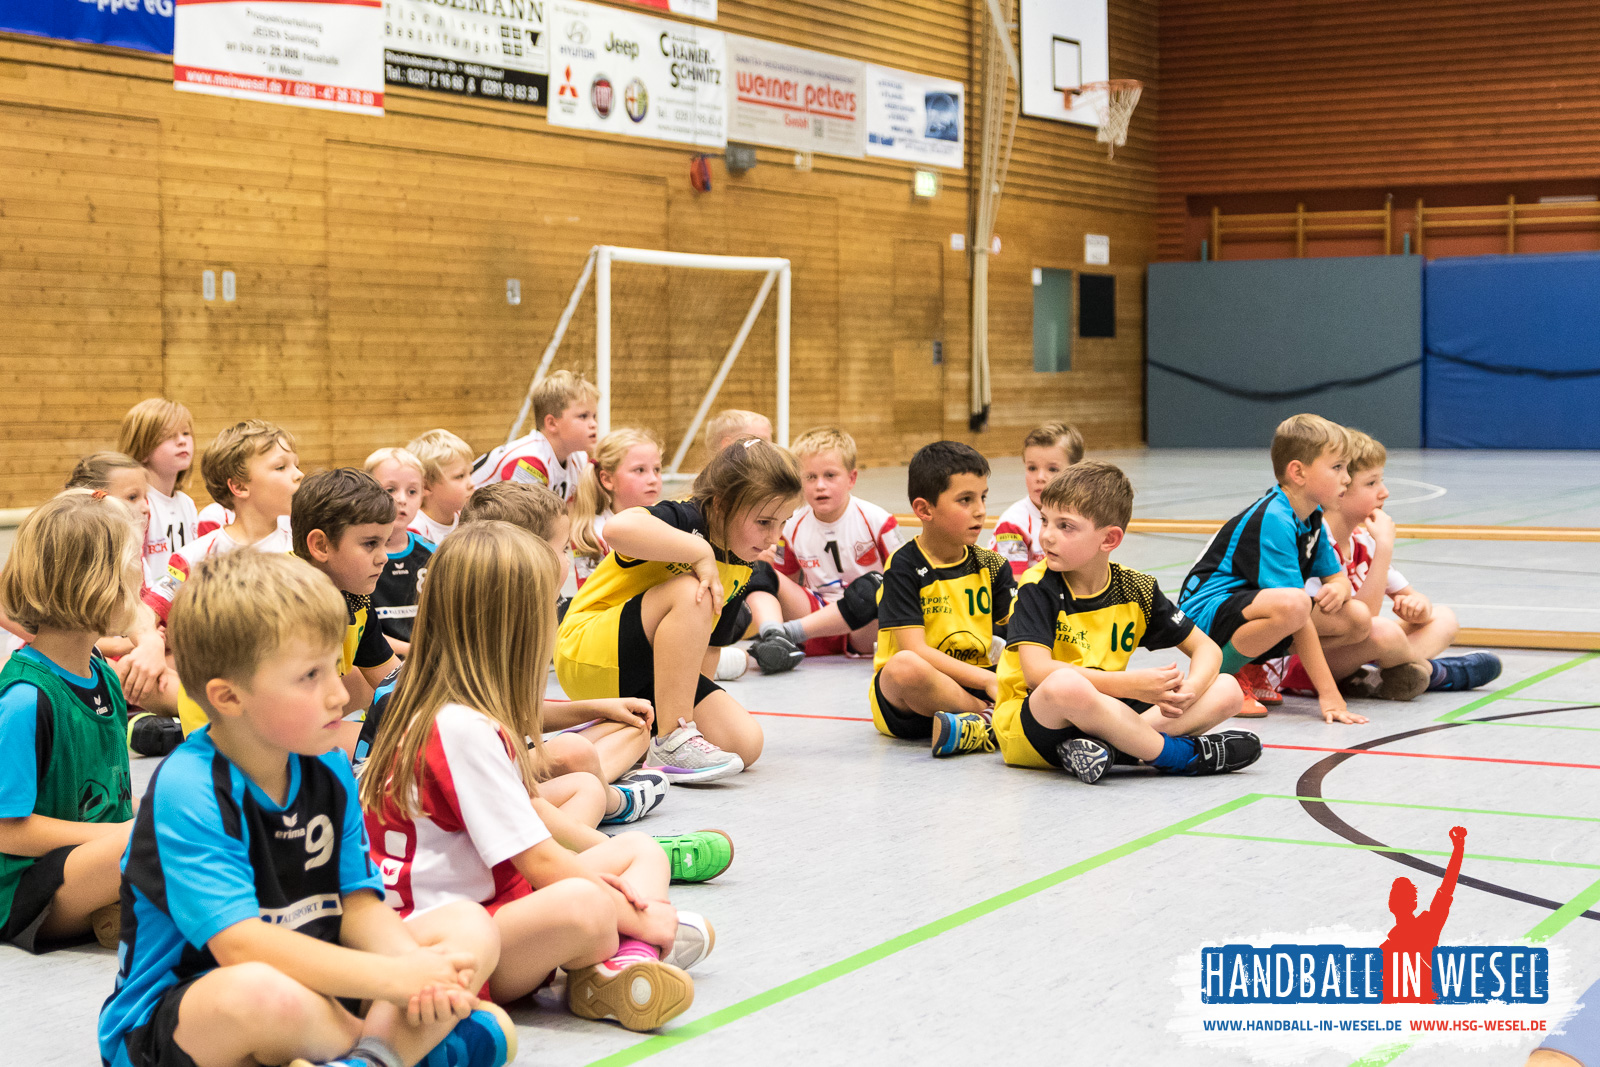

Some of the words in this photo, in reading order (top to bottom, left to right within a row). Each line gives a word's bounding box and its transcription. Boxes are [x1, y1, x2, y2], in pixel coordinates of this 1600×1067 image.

[605, 31, 639, 60] Jeep
[671, 63, 721, 88] SCHMITZ
[737, 71, 798, 103] werner
[804, 82, 857, 113] peters
[166, 521, 186, 553] 11
[824, 540, 844, 573] 1
[965, 586, 991, 616] 10
[1111, 621, 1135, 652] 16
[274, 828, 305, 839] erima
[305, 814, 334, 871] 9
